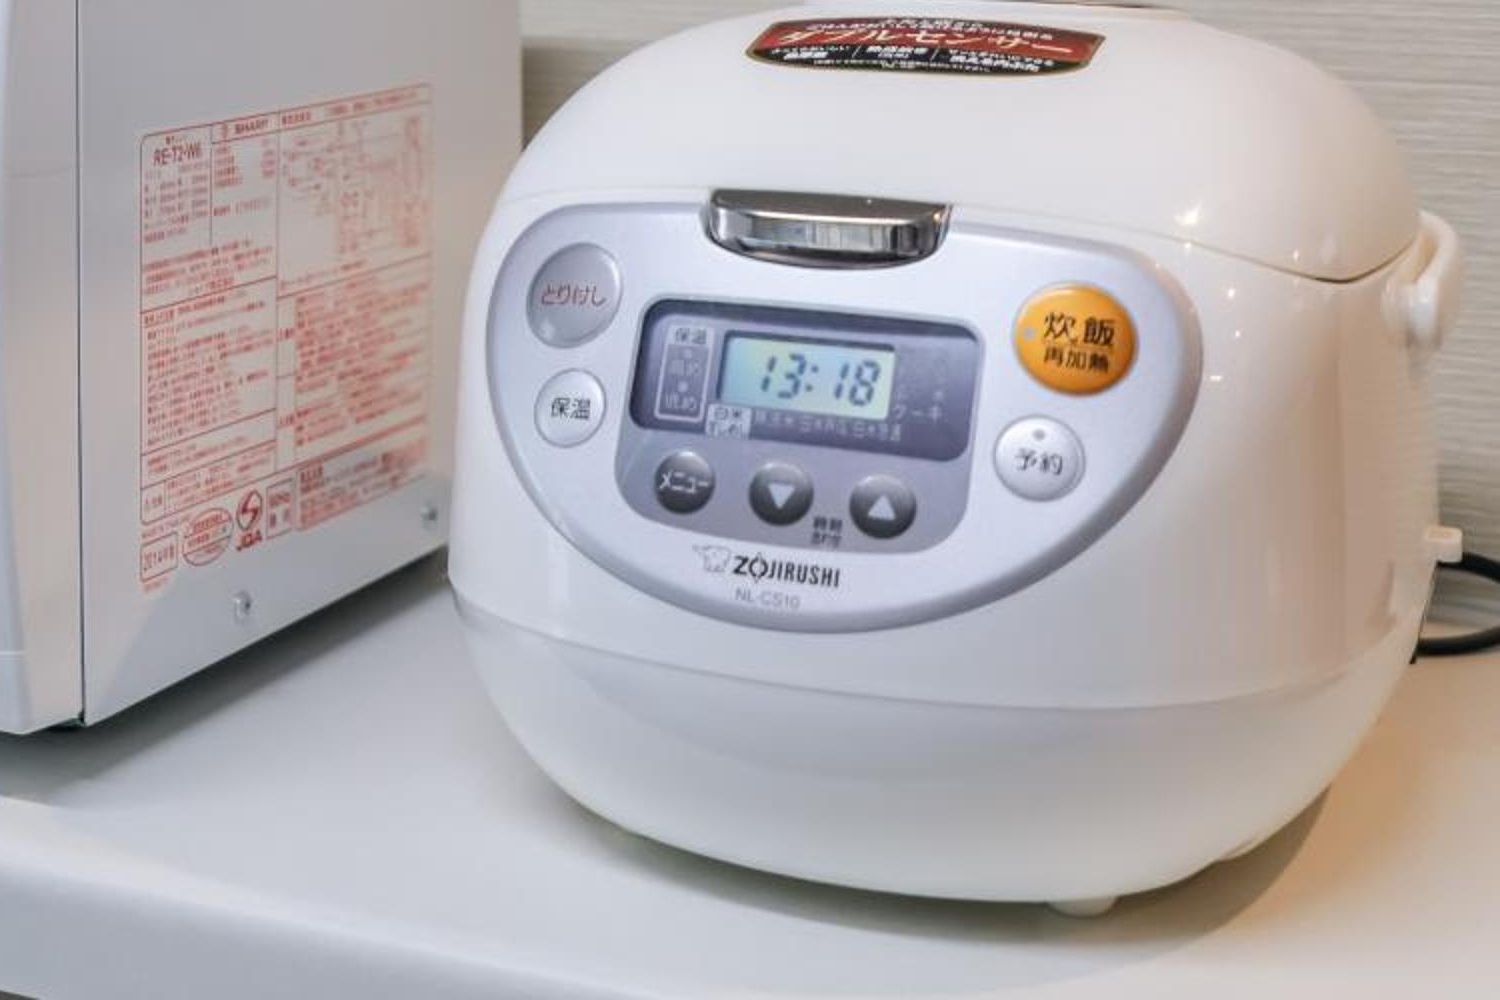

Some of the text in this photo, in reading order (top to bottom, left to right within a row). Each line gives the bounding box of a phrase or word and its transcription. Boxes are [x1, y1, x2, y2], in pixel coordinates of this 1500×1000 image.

[778, 28, 1073, 53] ダブルセンサー
[541, 283, 607, 306] とりけし
[1043, 311, 1115, 349] 炊飯
[1043, 347, 1109, 373] 再加熱
[760, 354, 881, 407] 13:18
[551, 397, 591, 420] 保温
[1015, 449, 1063, 475] 予約
[659, 472, 709, 494] メニュー
[733, 553, 840, 588] ZOJIRUSHI
[735, 588, 801, 609] NL-CS10
